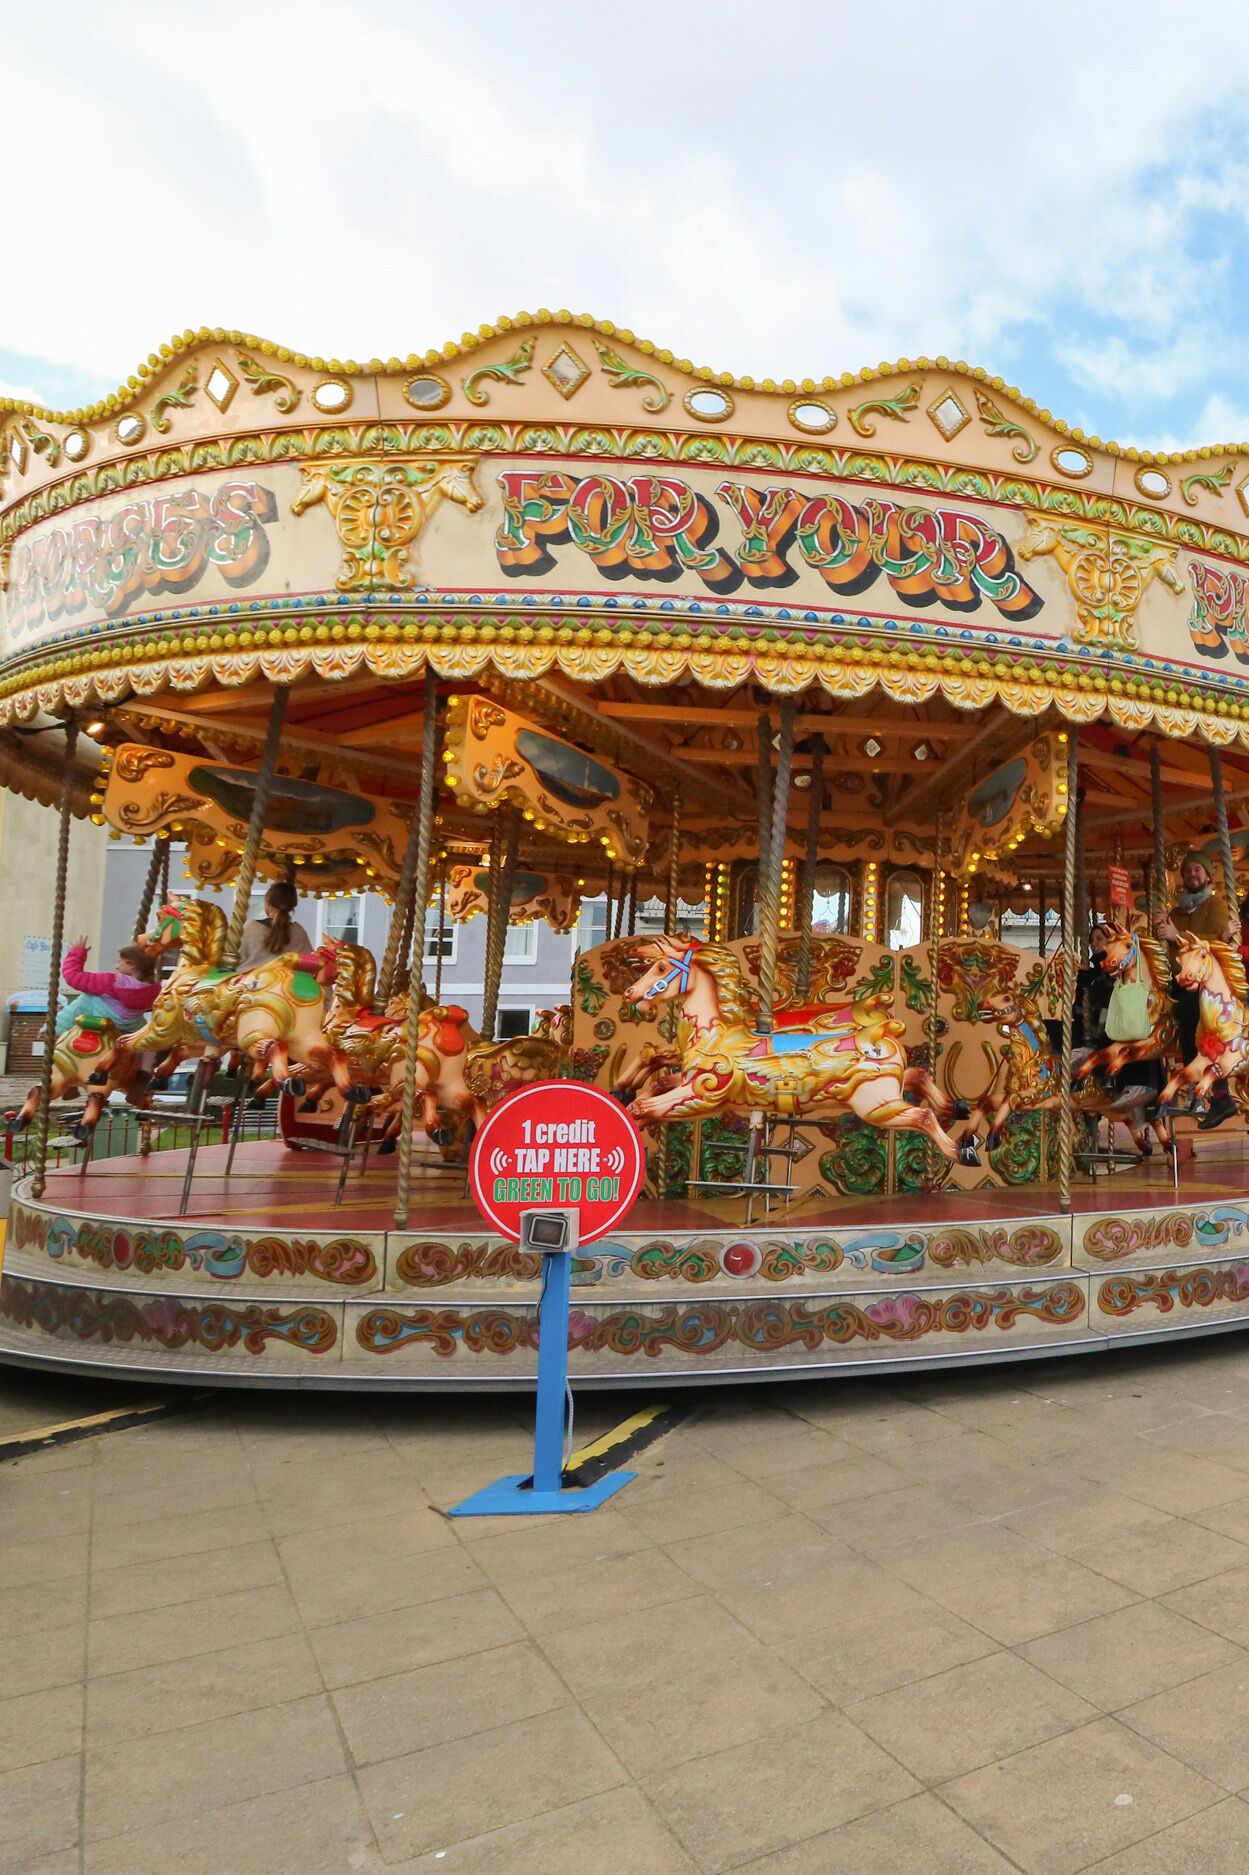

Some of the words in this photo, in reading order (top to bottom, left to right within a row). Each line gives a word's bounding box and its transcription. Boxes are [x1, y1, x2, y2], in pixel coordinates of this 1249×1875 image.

[495, 470, 745, 595] FOR
[714, 481, 1045, 621] YOUR
[521, 1119, 532, 1144] 1
[535, 1119, 596, 1144] credit
[515, 1148, 550, 1173] TAP
[553, 1148, 601, 1173] HERE
[492, 1177, 553, 1203] GREEN
[557, 1177, 582, 1202] TO
[586, 1177, 621, 1202] GO!
